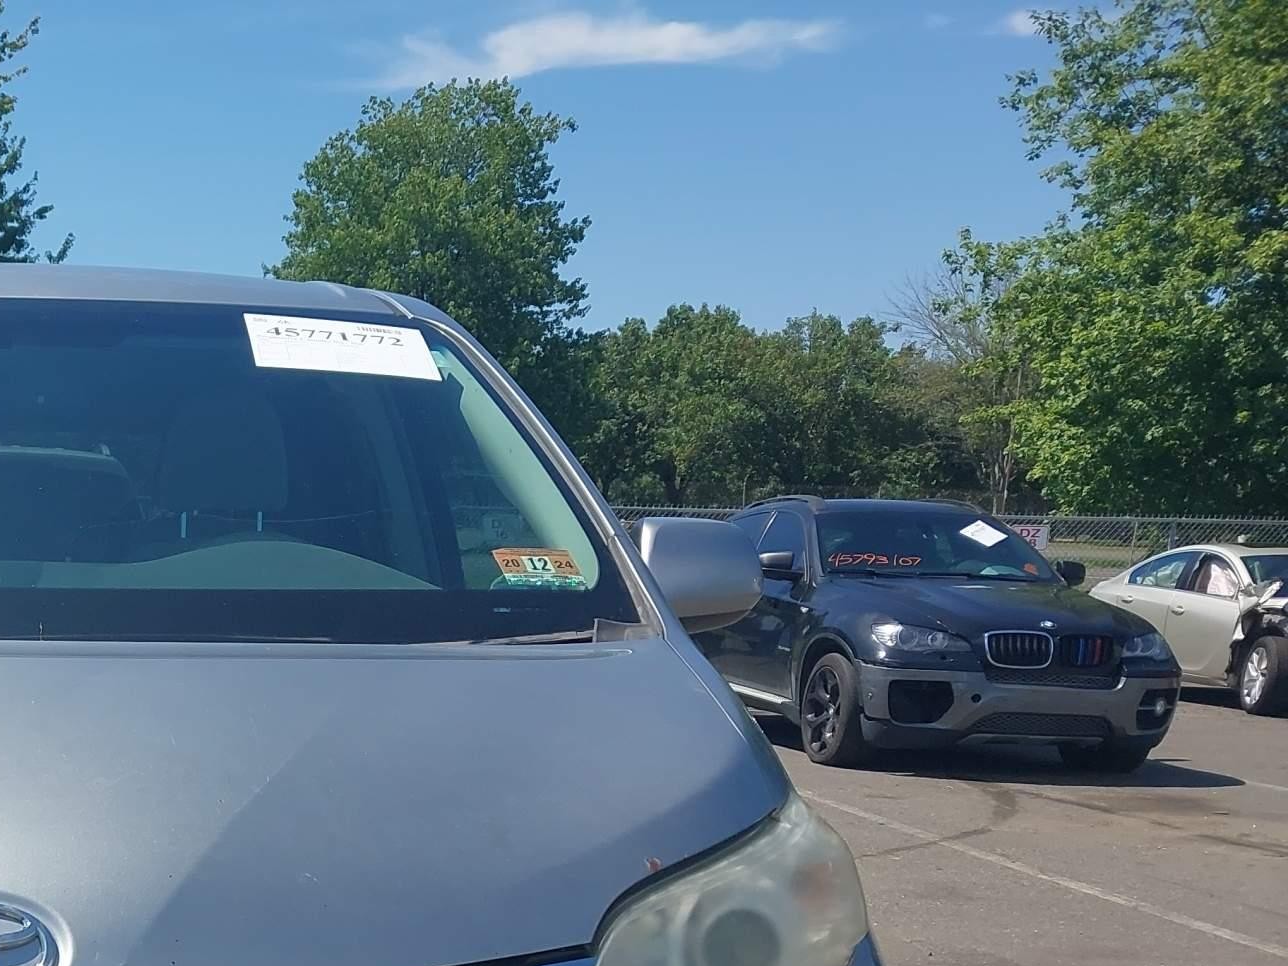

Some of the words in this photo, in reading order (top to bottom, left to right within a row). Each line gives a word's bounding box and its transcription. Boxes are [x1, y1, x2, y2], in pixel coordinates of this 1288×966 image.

[266, 326, 404, 347] 45771772
[502, 559, 520, 568] 20
[527, 558, 552, 571] 12
[553, 560, 573, 569] 24
